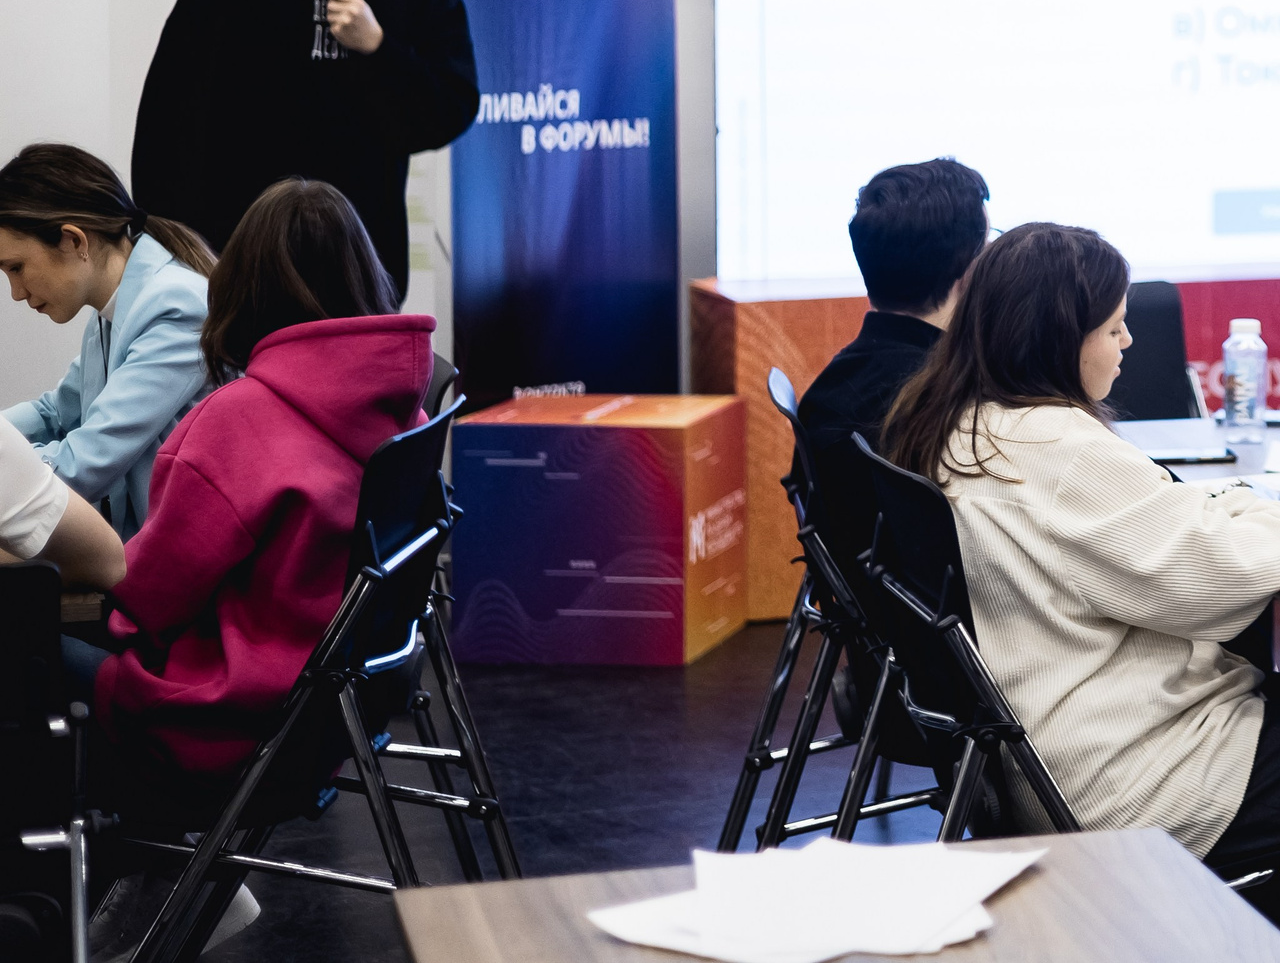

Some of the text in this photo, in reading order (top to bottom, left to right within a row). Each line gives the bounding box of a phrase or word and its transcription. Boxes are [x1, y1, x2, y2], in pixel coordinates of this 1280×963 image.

[1172, 7, 1206, 44] в)
[1172, 55, 1202, 93] г)
[476, 83, 580, 124] ЛИВАЙСЯ
[520, 117, 650, 155] В ФОРУМЫ!
